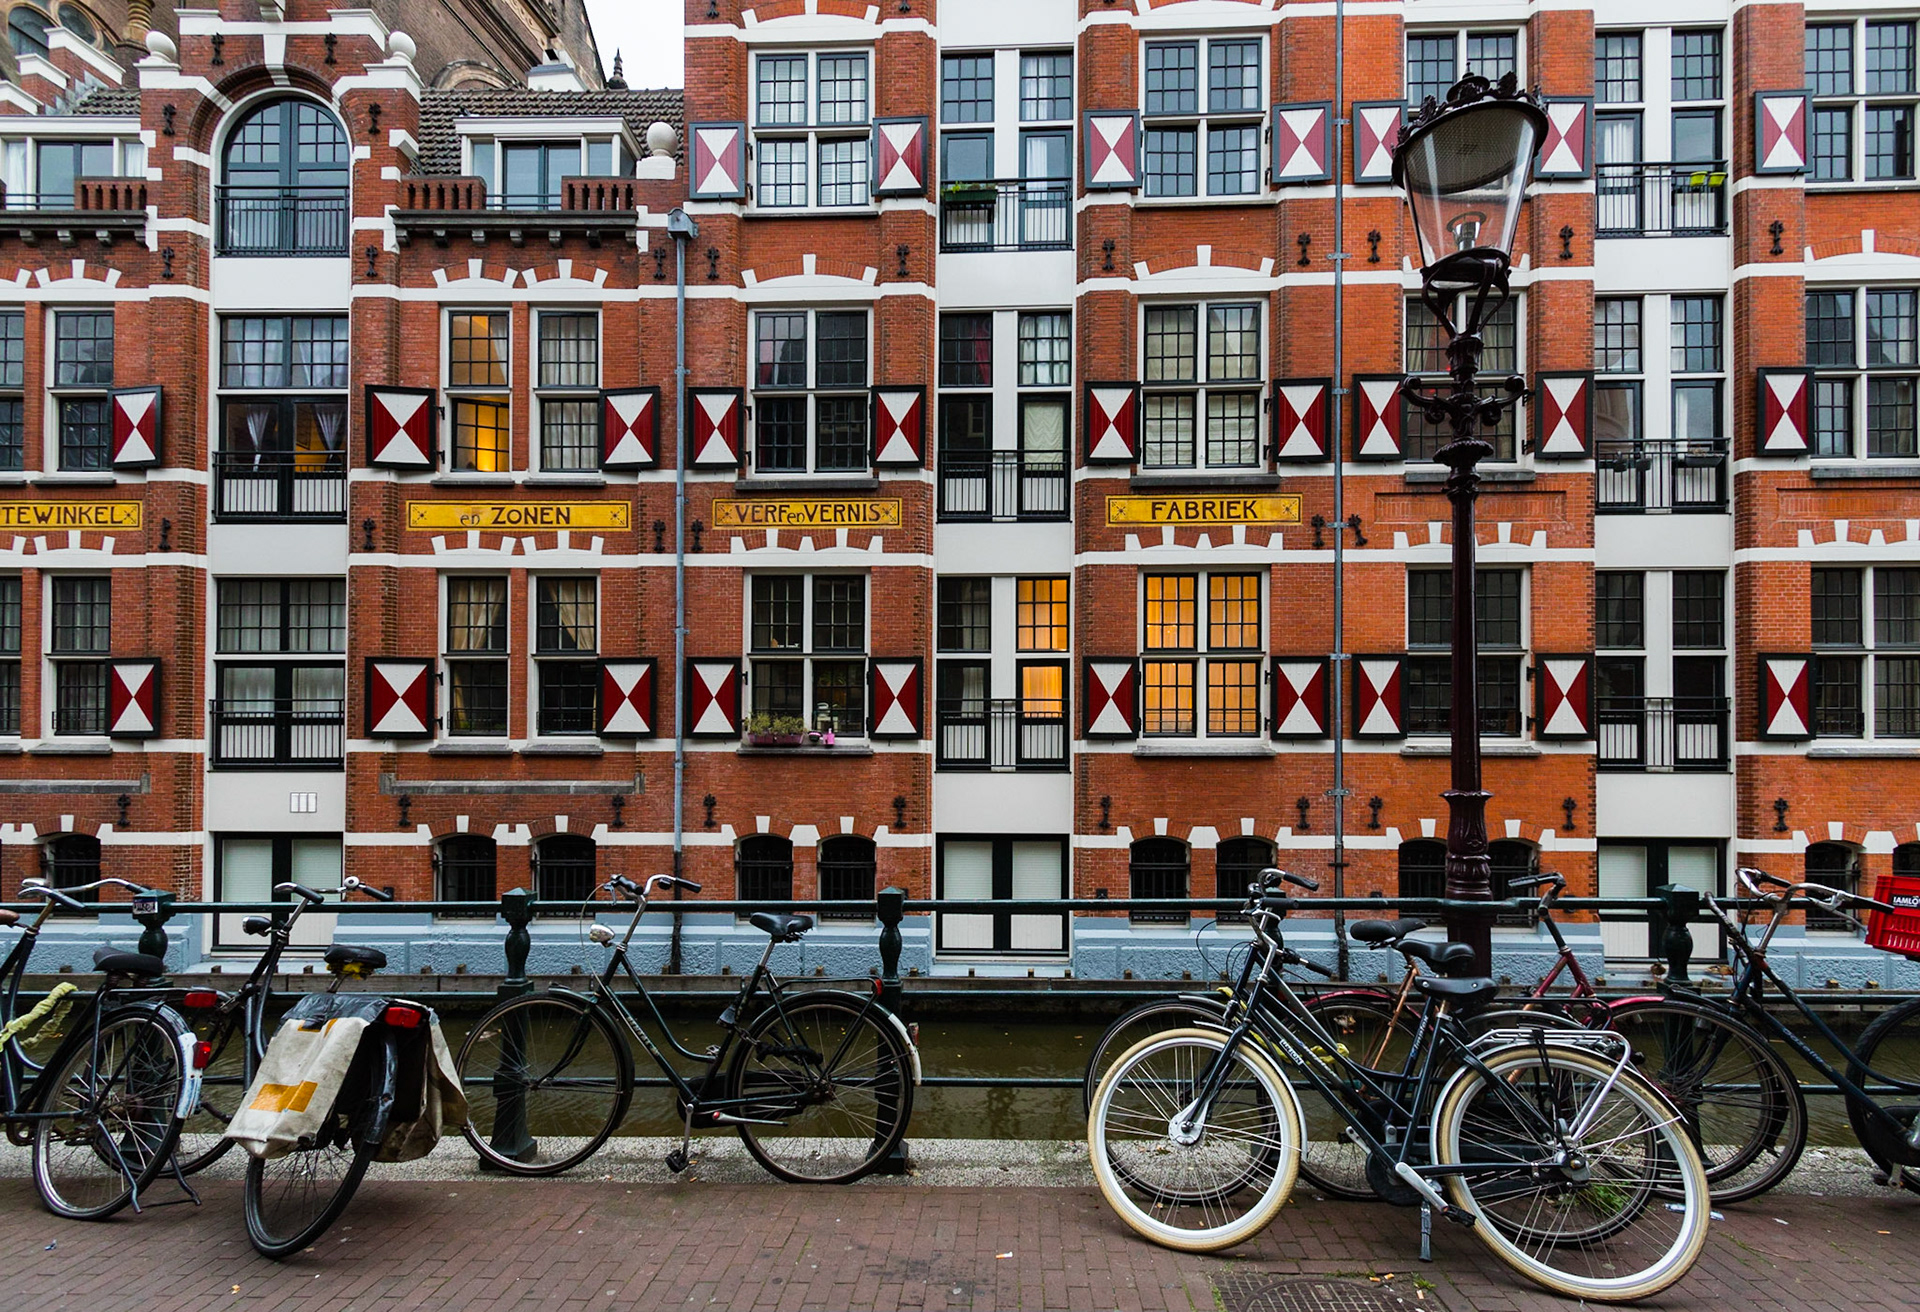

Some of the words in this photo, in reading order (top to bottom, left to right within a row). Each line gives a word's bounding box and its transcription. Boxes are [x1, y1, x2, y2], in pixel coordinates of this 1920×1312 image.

[2, 506, 123, 524] TEWINKEL
[460, 512, 480, 526] en
[491, 507, 571, 525] ZONEN
[735, 504, 790, 523] VERF
[787, 511, 805, 525] en
[804, 503, 881, 523] VERNIS
[1151, 500, 1258, 520] FABRIEK
